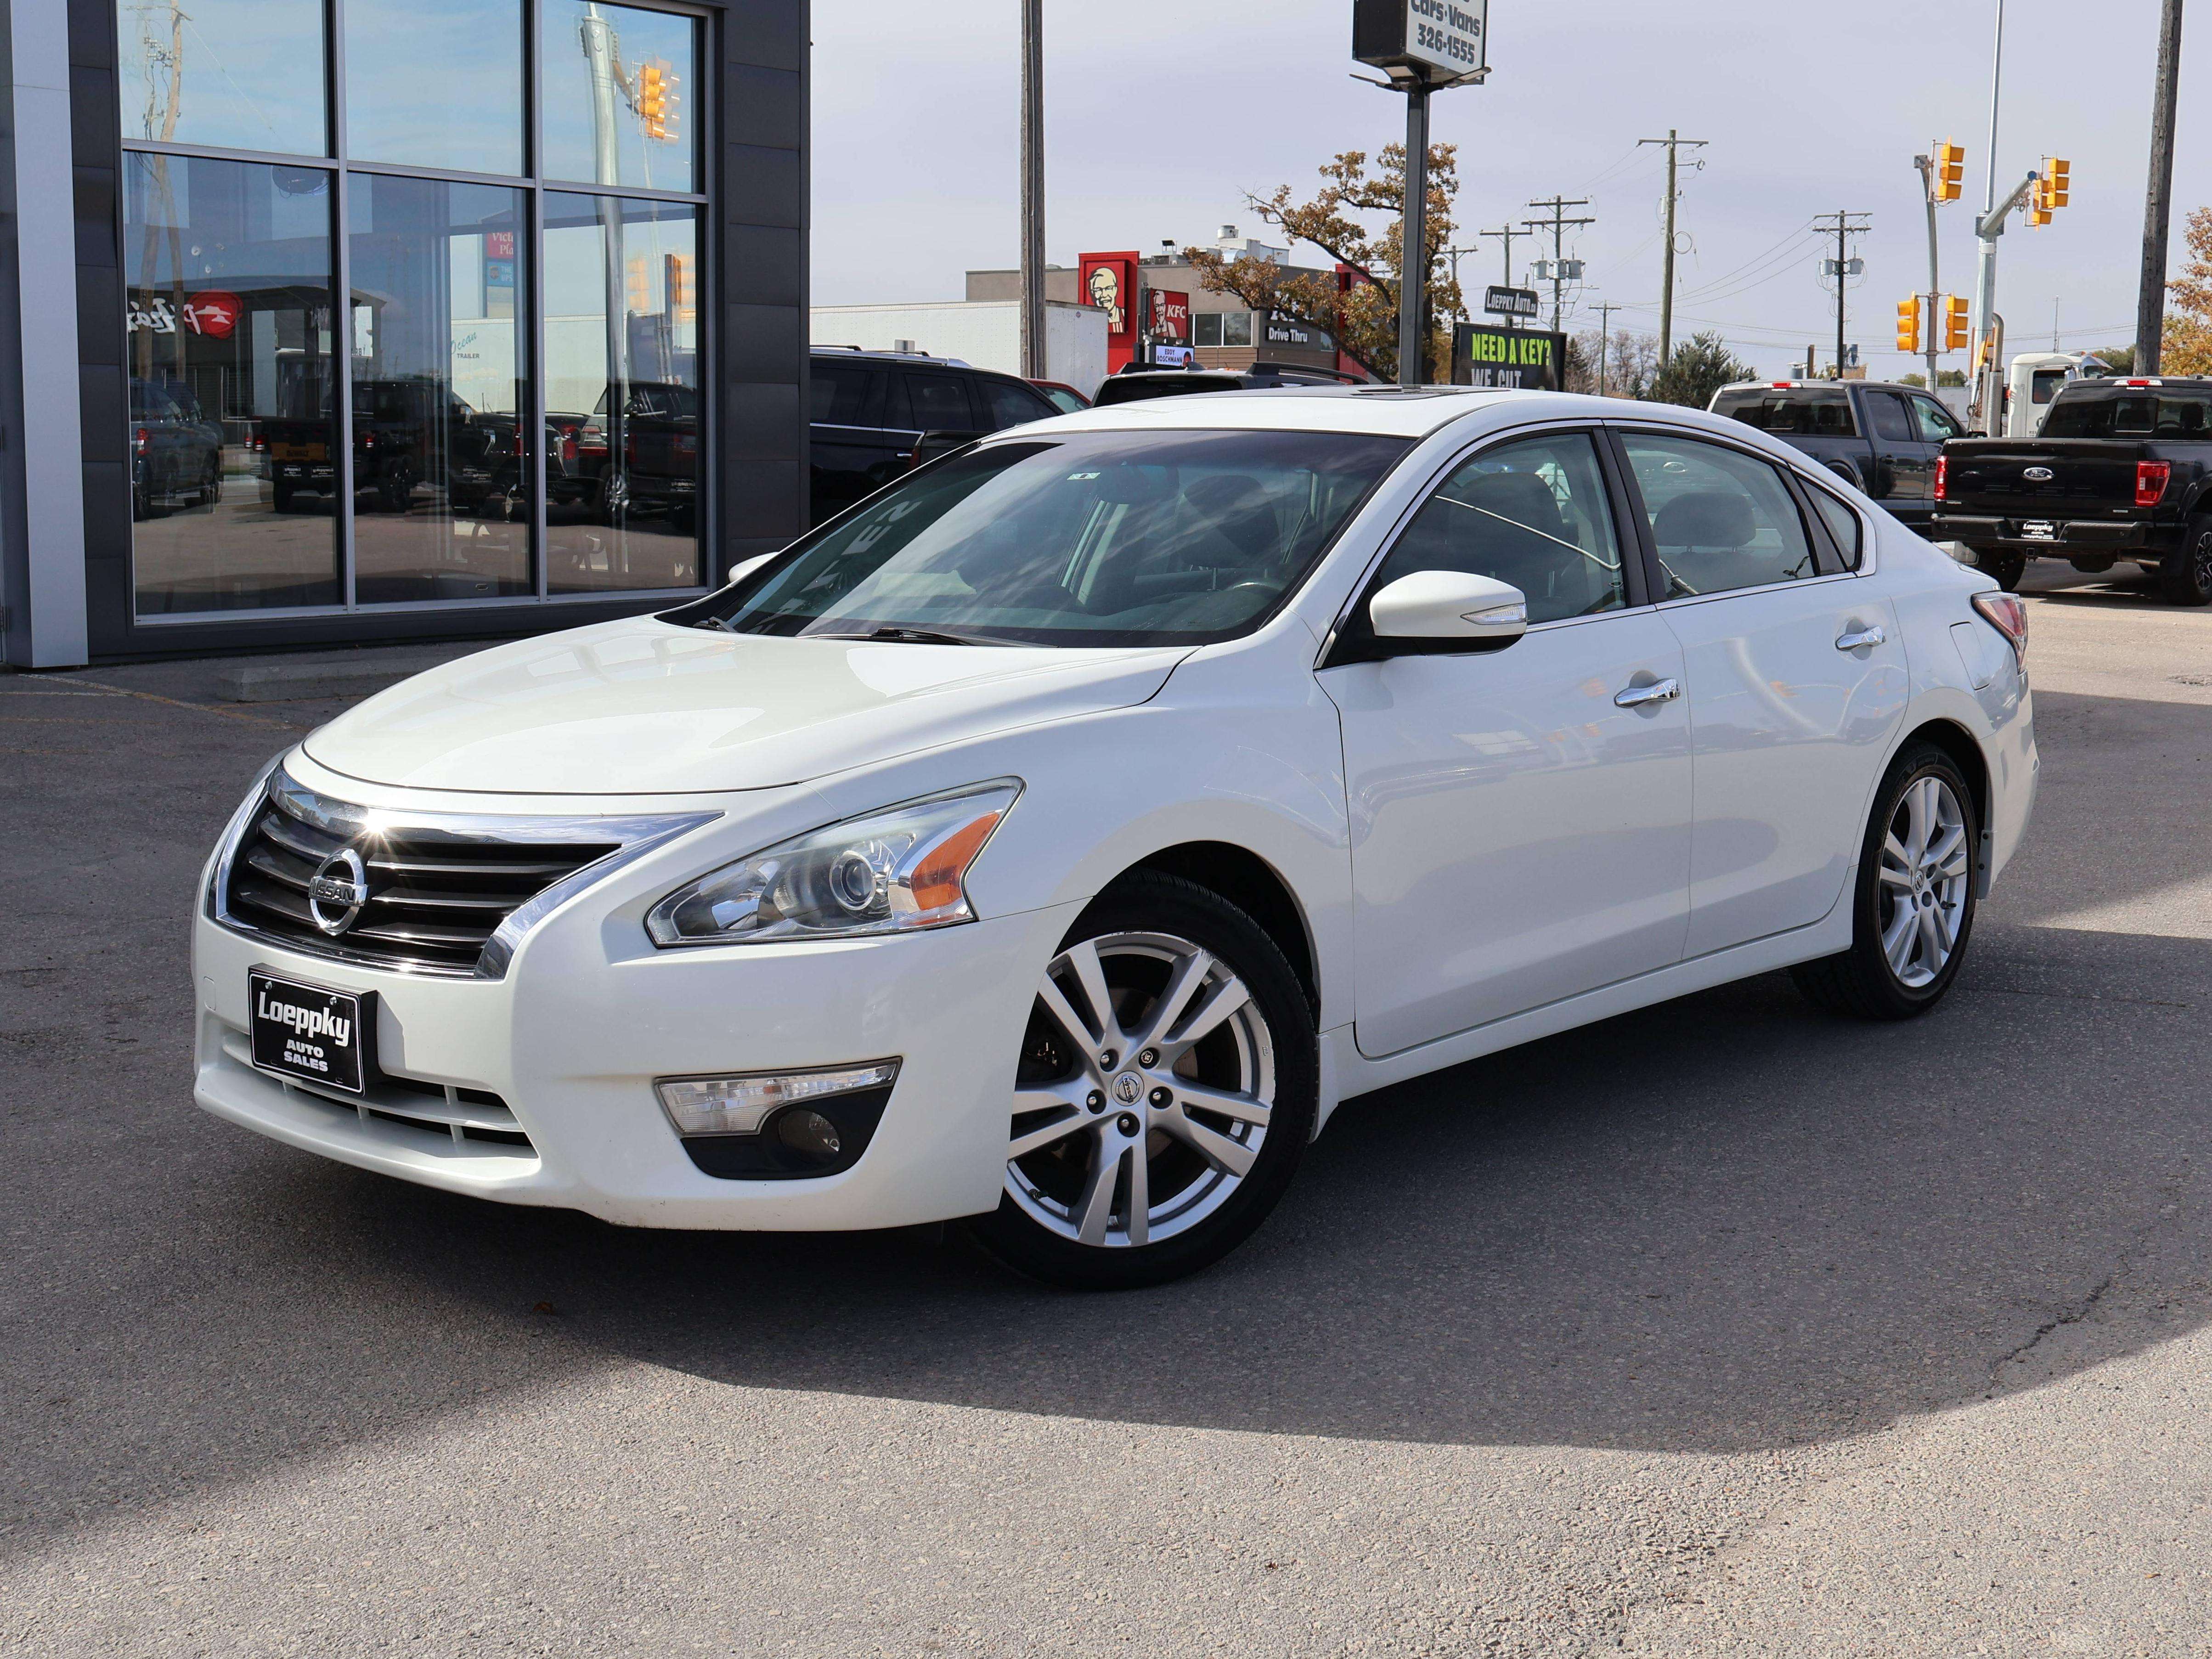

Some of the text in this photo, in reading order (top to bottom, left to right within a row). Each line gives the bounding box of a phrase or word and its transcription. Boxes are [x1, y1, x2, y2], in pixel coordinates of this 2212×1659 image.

[1417, 23, 1475, 64] 326-1555
[1487, 289, 1514, 310] LOEPPKY
[1167, 305, 1186, 319] KFC
[1269, 327, 1308, 343] Drive Thru
[1157, 355, 1183, 363] BOSCHMANN
[1472, 333, 1552, 366] NEED A KEY?
[2023, 523, 2054, 531] Loeppky
[310, 878, 356, 902] NISSAN
[258, 992, 350, 1047] Loeppky
[286, 1039, 324, 1058] AUTO
[284, 1051, 328, 1072] SALES
